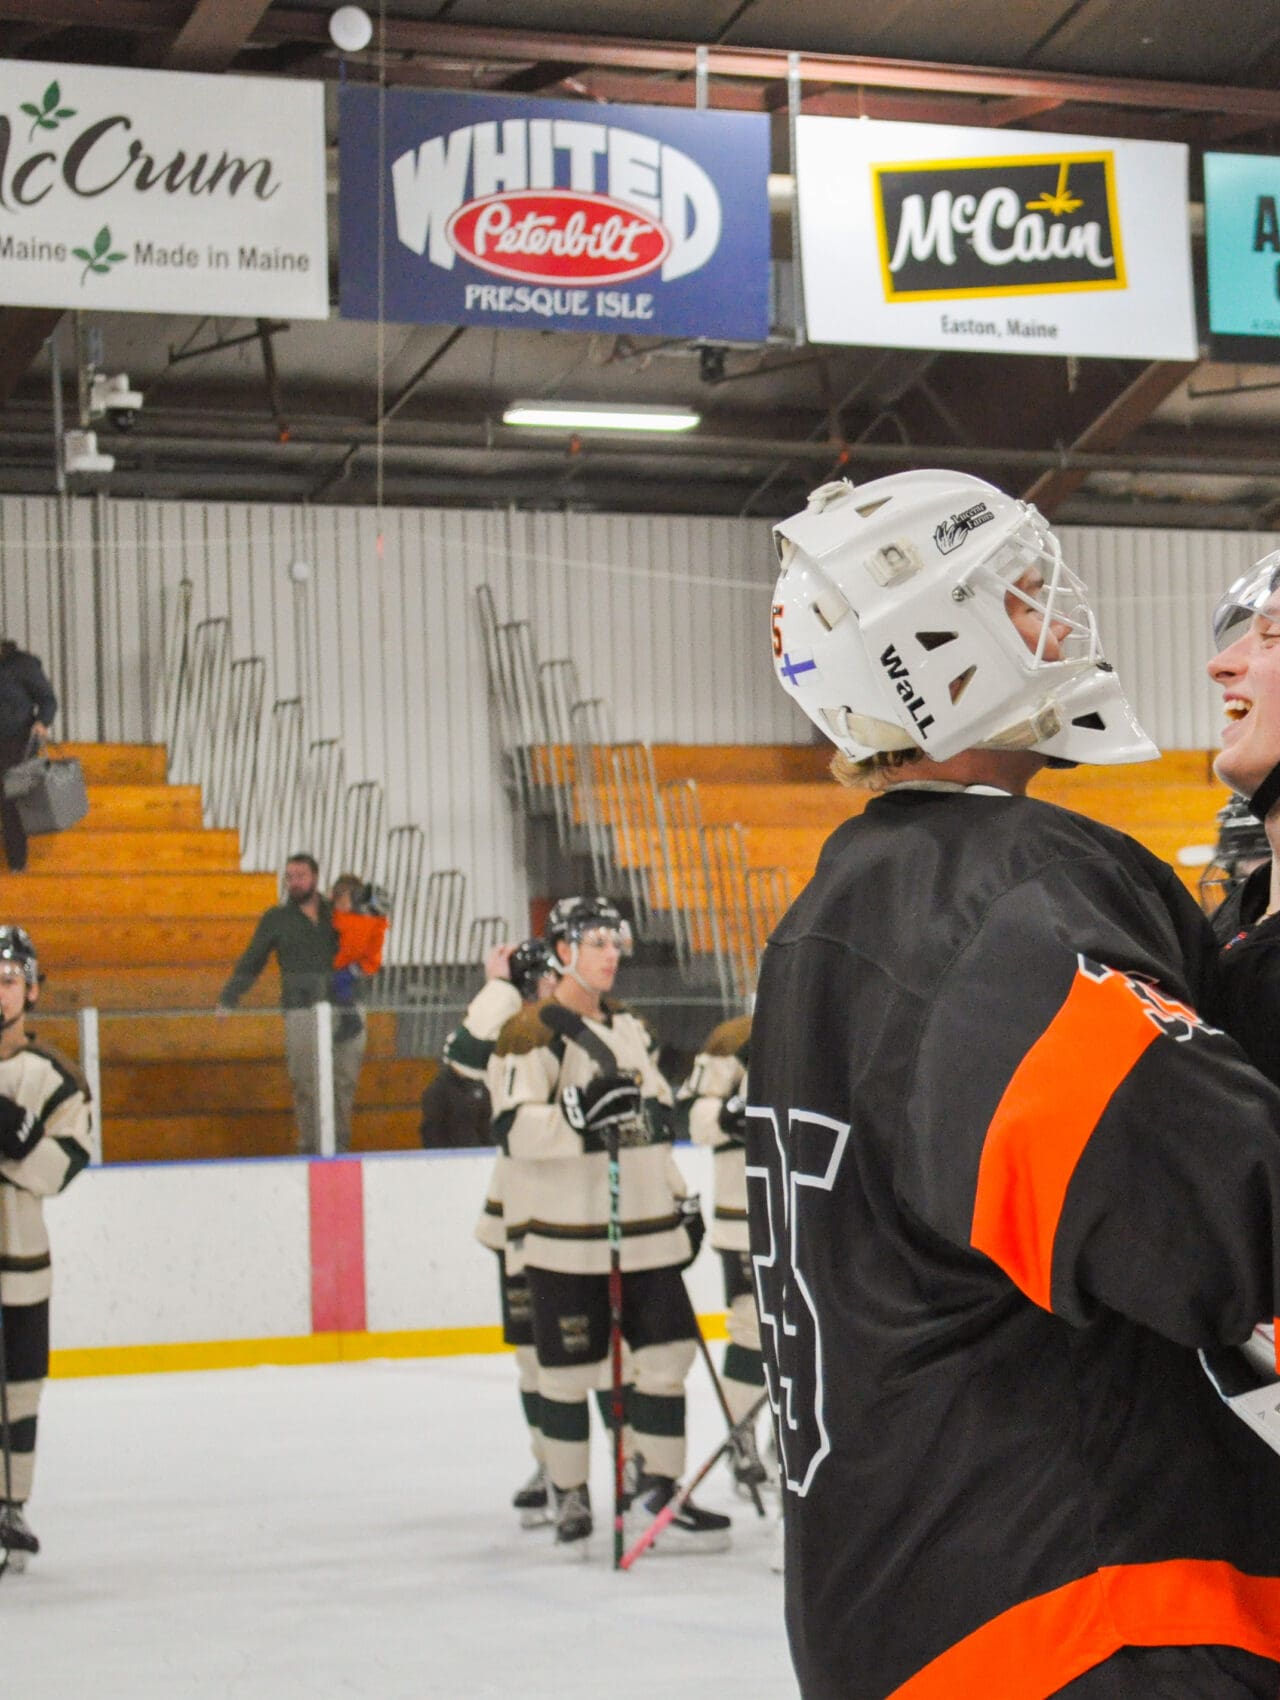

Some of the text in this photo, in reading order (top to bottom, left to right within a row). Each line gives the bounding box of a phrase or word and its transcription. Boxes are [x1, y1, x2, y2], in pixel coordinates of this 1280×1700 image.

[0, 114, 280, 214] cCrum
[391, 119, 722, 283] WHITED
[474, 201, 656, 263] Peterbilt
[889, 186, 1114, 273] McCain
[134, 242, 199, 268] Made
[207, 246, 230, 270] in
[238, 246, 311, 273] Maine
[464, 284, 655, 320] PRESQUE ISLE
[941, 314, 1058, 338] Easton, Maine
